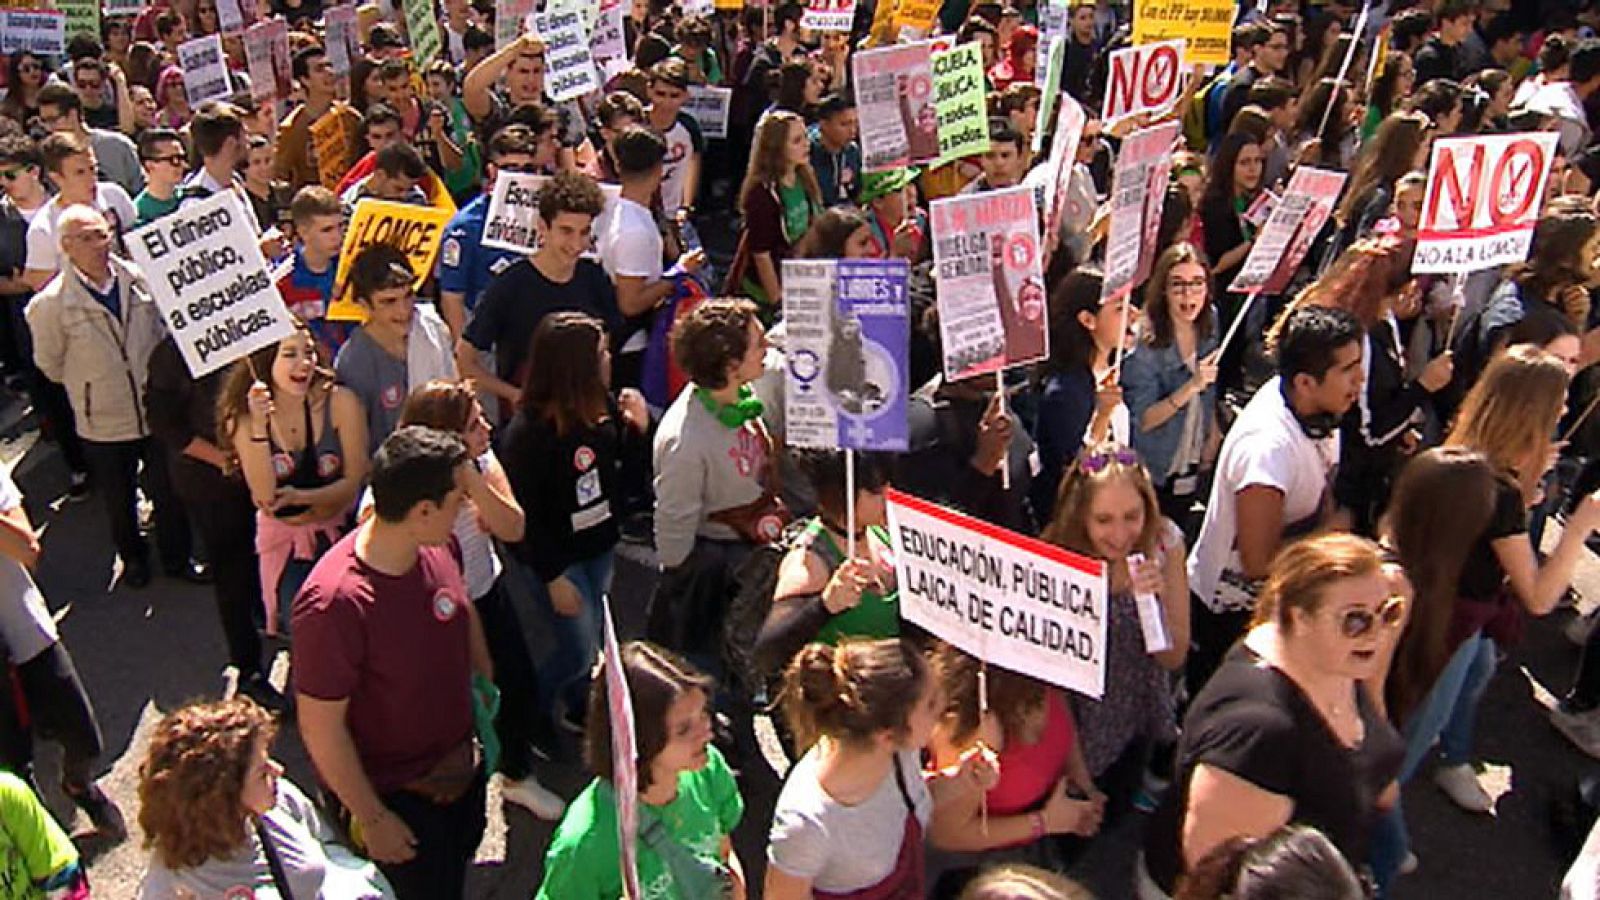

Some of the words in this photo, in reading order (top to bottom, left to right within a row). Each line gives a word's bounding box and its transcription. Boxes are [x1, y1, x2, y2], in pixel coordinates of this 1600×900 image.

[1106, 45, 1180, 119] NO
[1425, 139, 1545, 229] NO
[142, 228, 170, 260] El
[169, 207, 232, 249] dinero
[1415, 246, 1442, 266] NO
[167, 245, 245, 298] público,
[169, 308, 188, 331] a
[187, 269, 272, 322] escuelas
[193, 308, 277, 364] públicas.
[904, 564, 964, 618] LAICA,
[967, 592, 994, 631] DE
[998, 604, 1100, 666] CALIDAD.
[1011, 561, 1101, 625] PÚBLICA,
